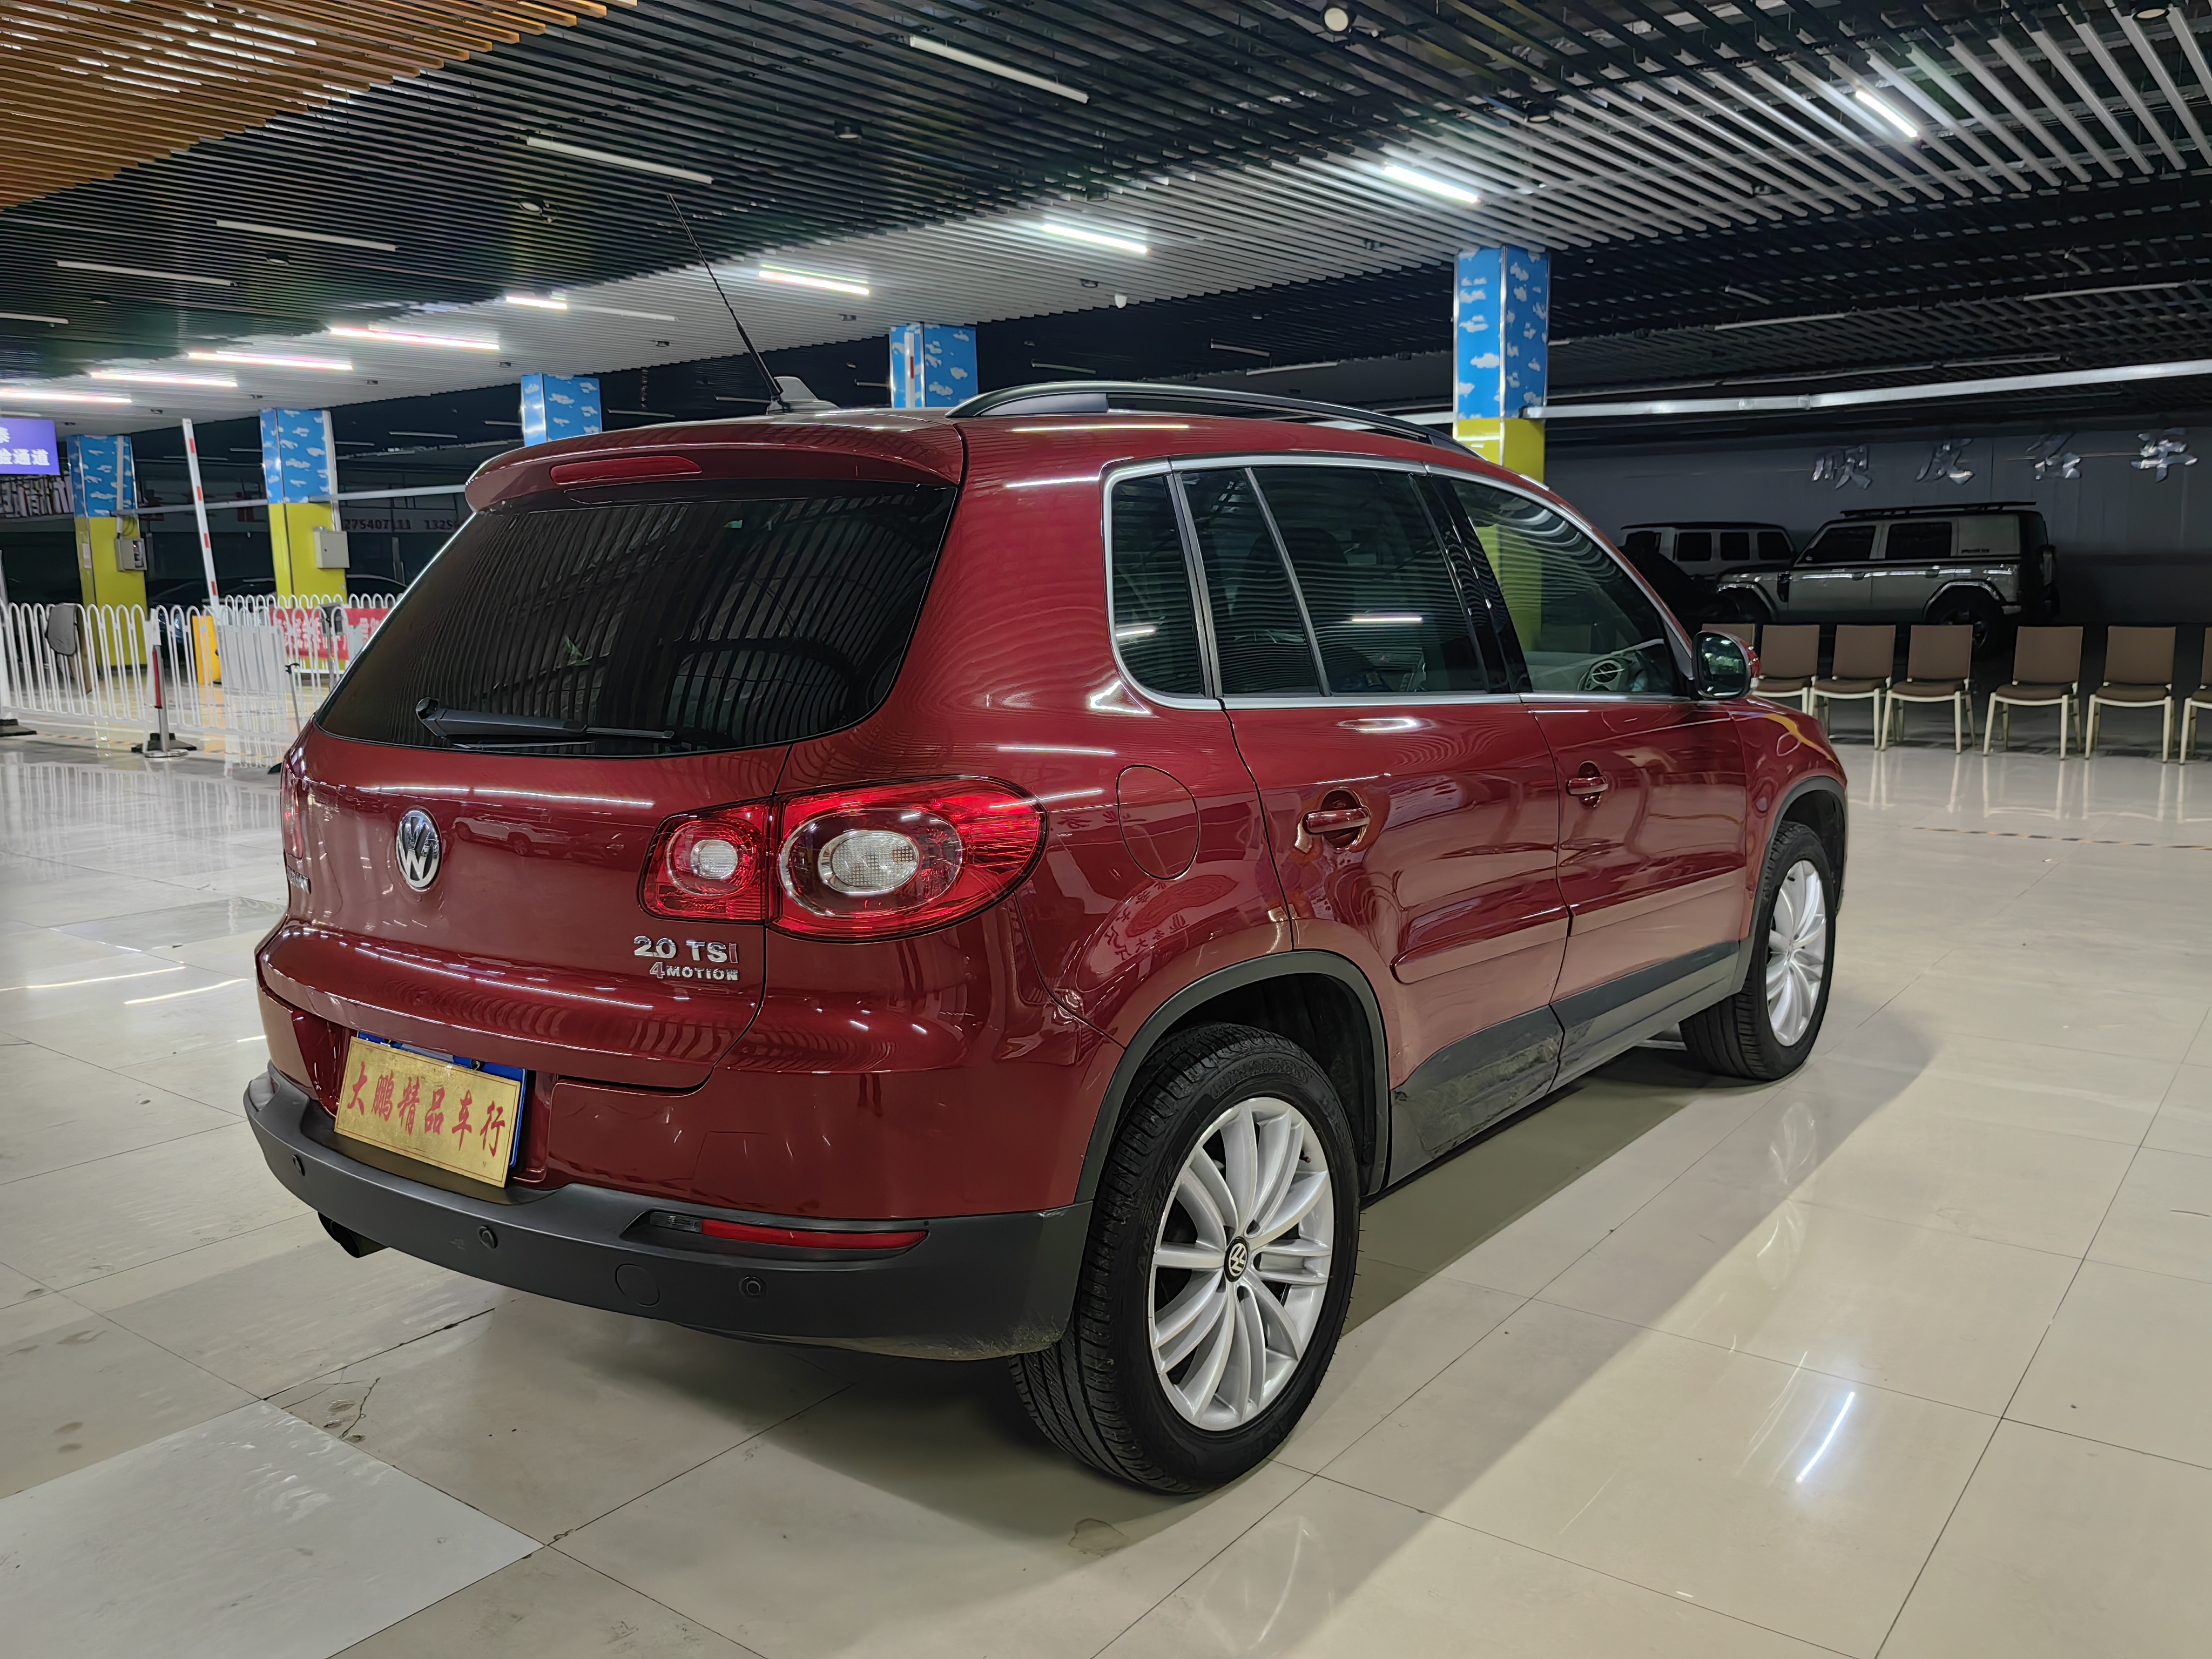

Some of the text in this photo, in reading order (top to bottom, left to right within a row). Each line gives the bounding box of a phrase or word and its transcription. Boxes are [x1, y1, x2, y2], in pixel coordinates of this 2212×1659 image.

[685, 939, 738, 964] TSI
[649, 961, 738, 981] 4MOTION
[347, 1060, 506, 1158] 大鹏精品车行
